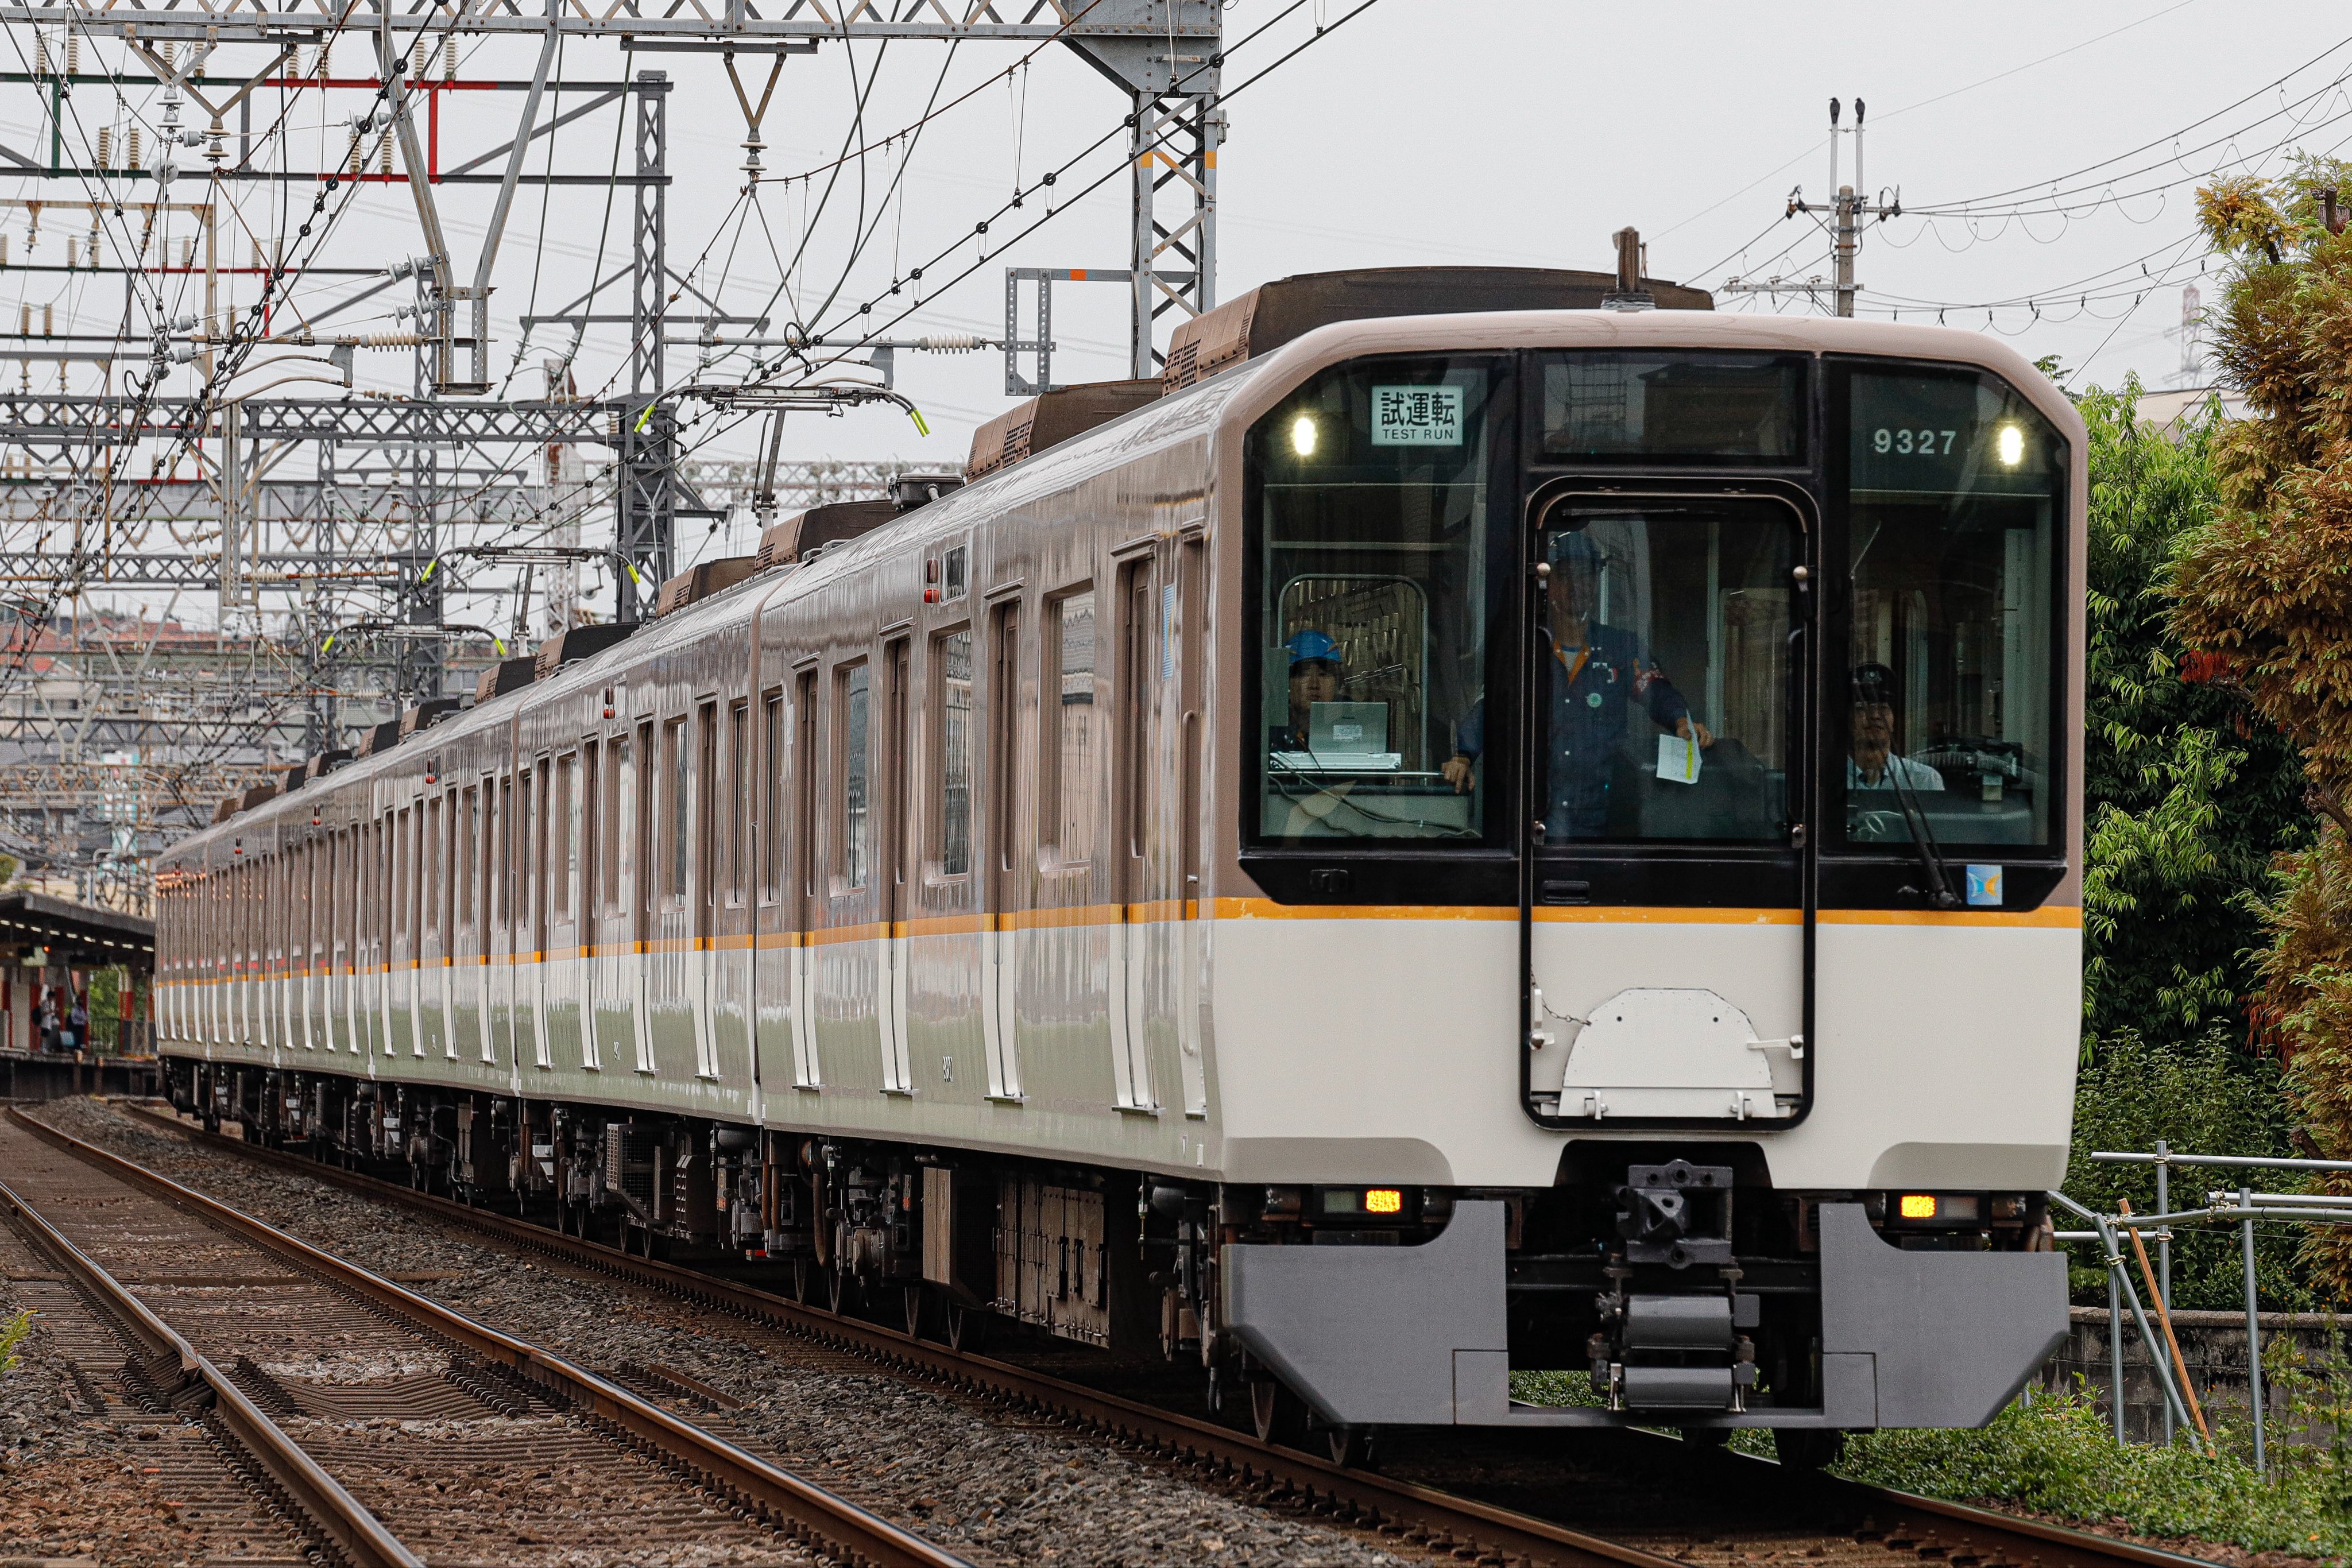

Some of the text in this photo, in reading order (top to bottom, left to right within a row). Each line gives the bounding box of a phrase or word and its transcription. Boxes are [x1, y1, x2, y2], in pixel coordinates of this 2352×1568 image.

[1380, 392, 1455, 427] 試運転
[1383, 429, 1453, 440] TEST RUN
[1874, 428, 1957, 455] 9327
